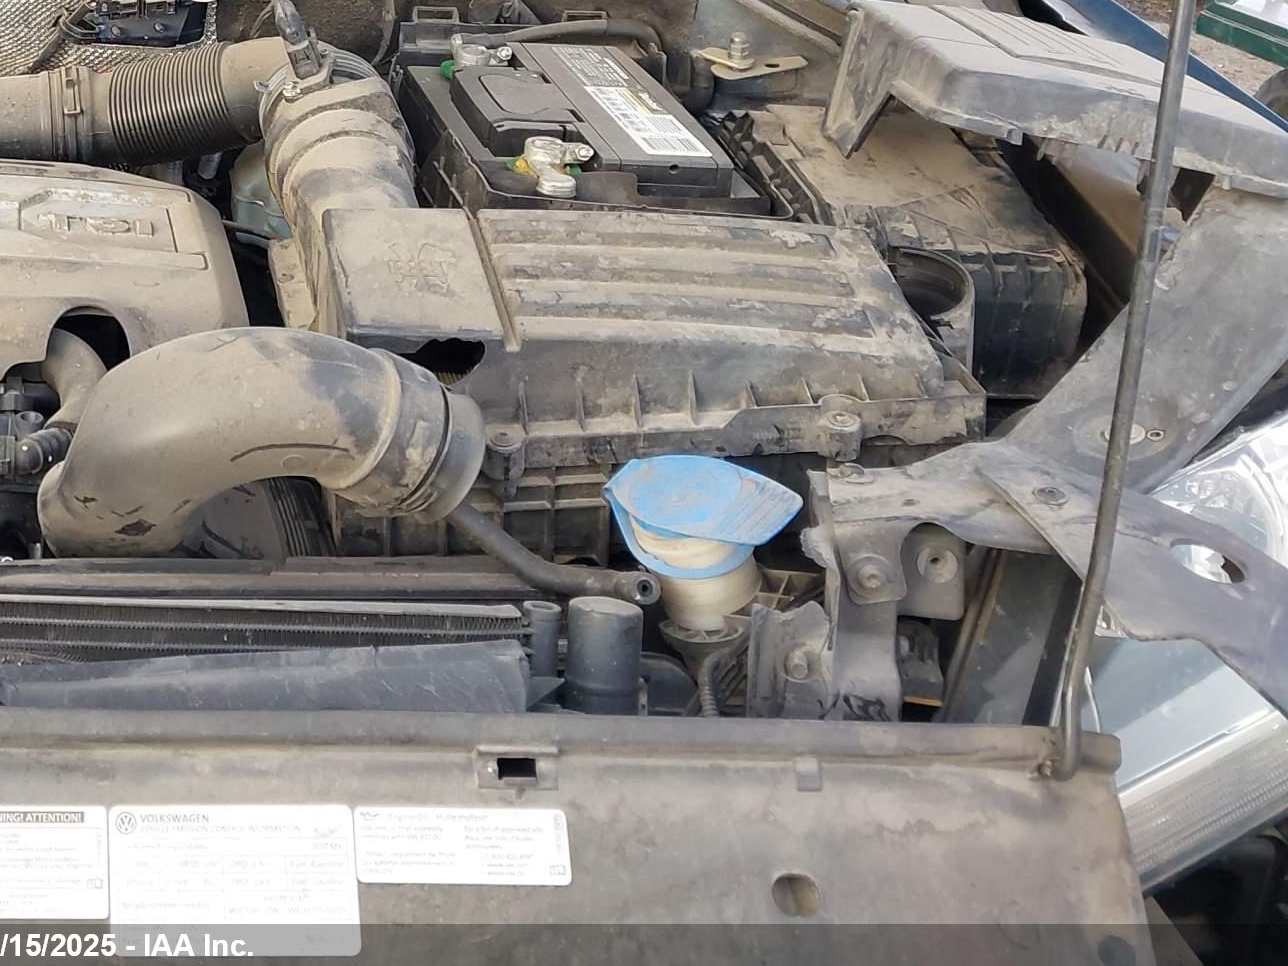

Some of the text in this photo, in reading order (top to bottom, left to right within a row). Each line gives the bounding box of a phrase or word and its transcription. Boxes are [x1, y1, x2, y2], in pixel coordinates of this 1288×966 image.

[38, 213, 154, 237] TSI
[25, 812, 82, 822] ATTENTION!
[140, 813, 210, 823] VOLKSWAGEN
